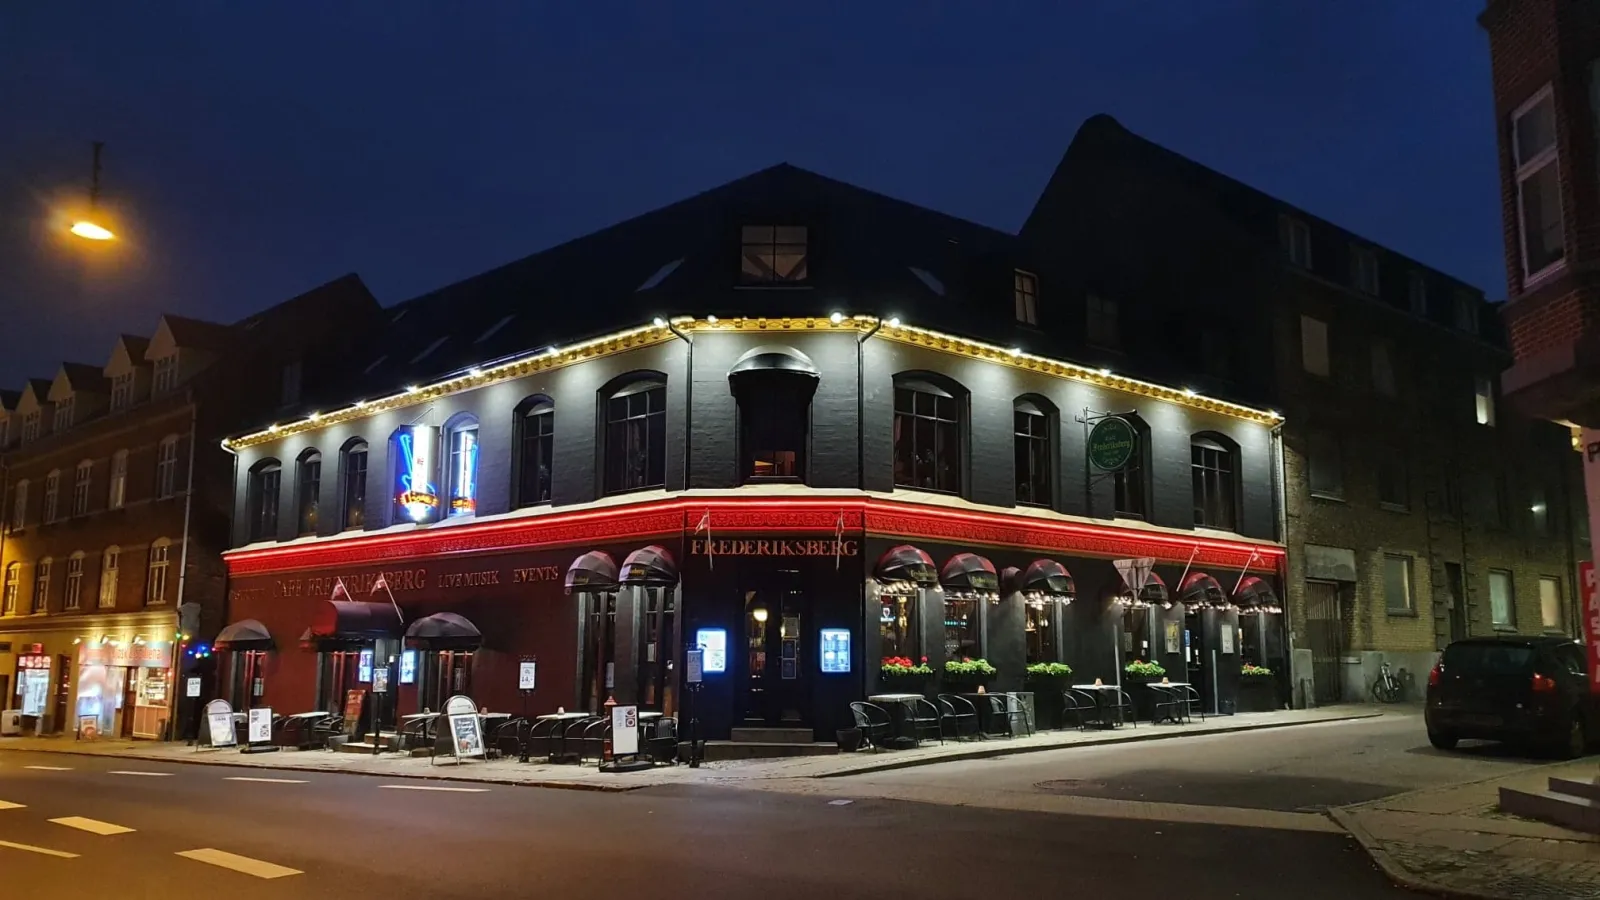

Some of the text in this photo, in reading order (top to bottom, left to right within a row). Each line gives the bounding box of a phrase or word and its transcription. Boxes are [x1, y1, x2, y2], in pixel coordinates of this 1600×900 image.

[691, 539, 858, 555] FREDERIKSBERG
[307, 568, 428, 597] FREERIKBERG
[513, 566, 559, 583] EVENTS
